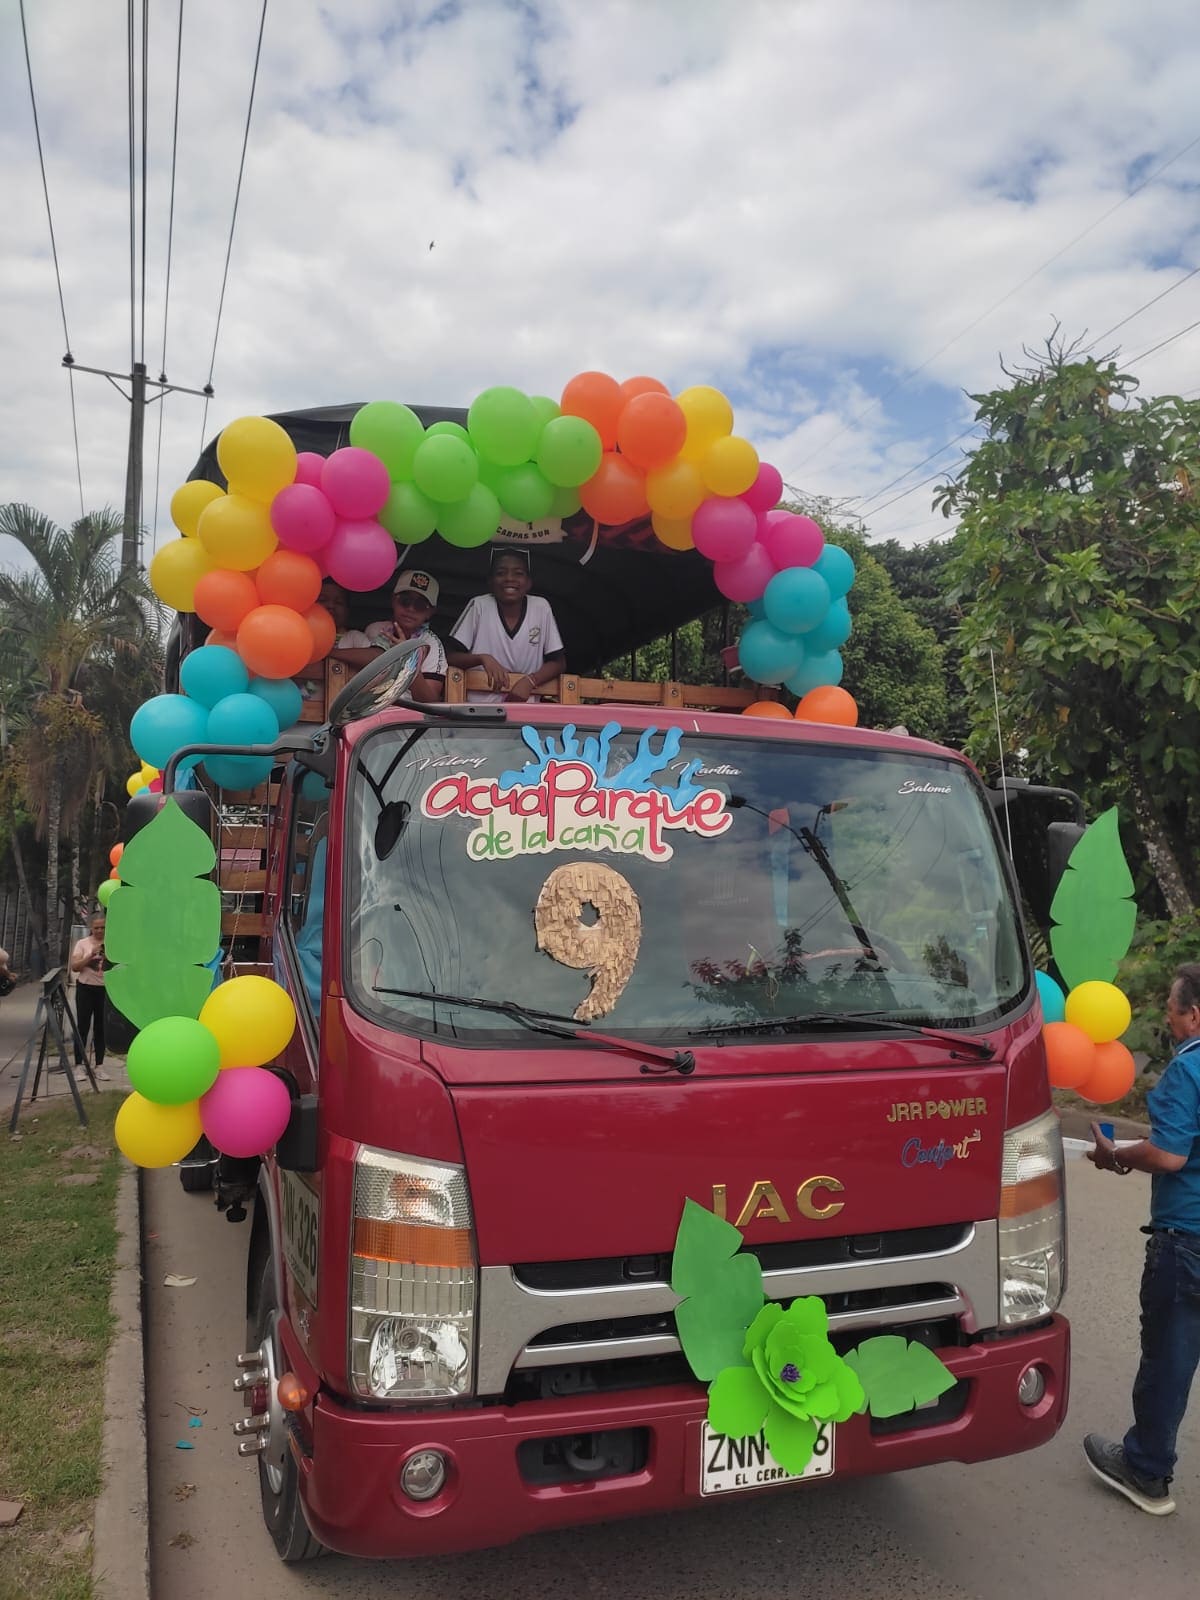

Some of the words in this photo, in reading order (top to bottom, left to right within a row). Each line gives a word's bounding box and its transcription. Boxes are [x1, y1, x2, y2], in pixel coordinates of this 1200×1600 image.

[405, 754, 488, 771] Valery
[898, 780, 951, 794] Salomé
[471, 814, 514, 856] de
[521, 817, 546, 849] la
[559, 824, 646, 851] caña
[534, 861, 642, 1021] 9
[886, 1102, 923, 1122] JRR
[925, 1097, 988, 1119] POWER
[735, 1473, 748, 1485] EL
[756, 1468, 793, 1482] CERR
